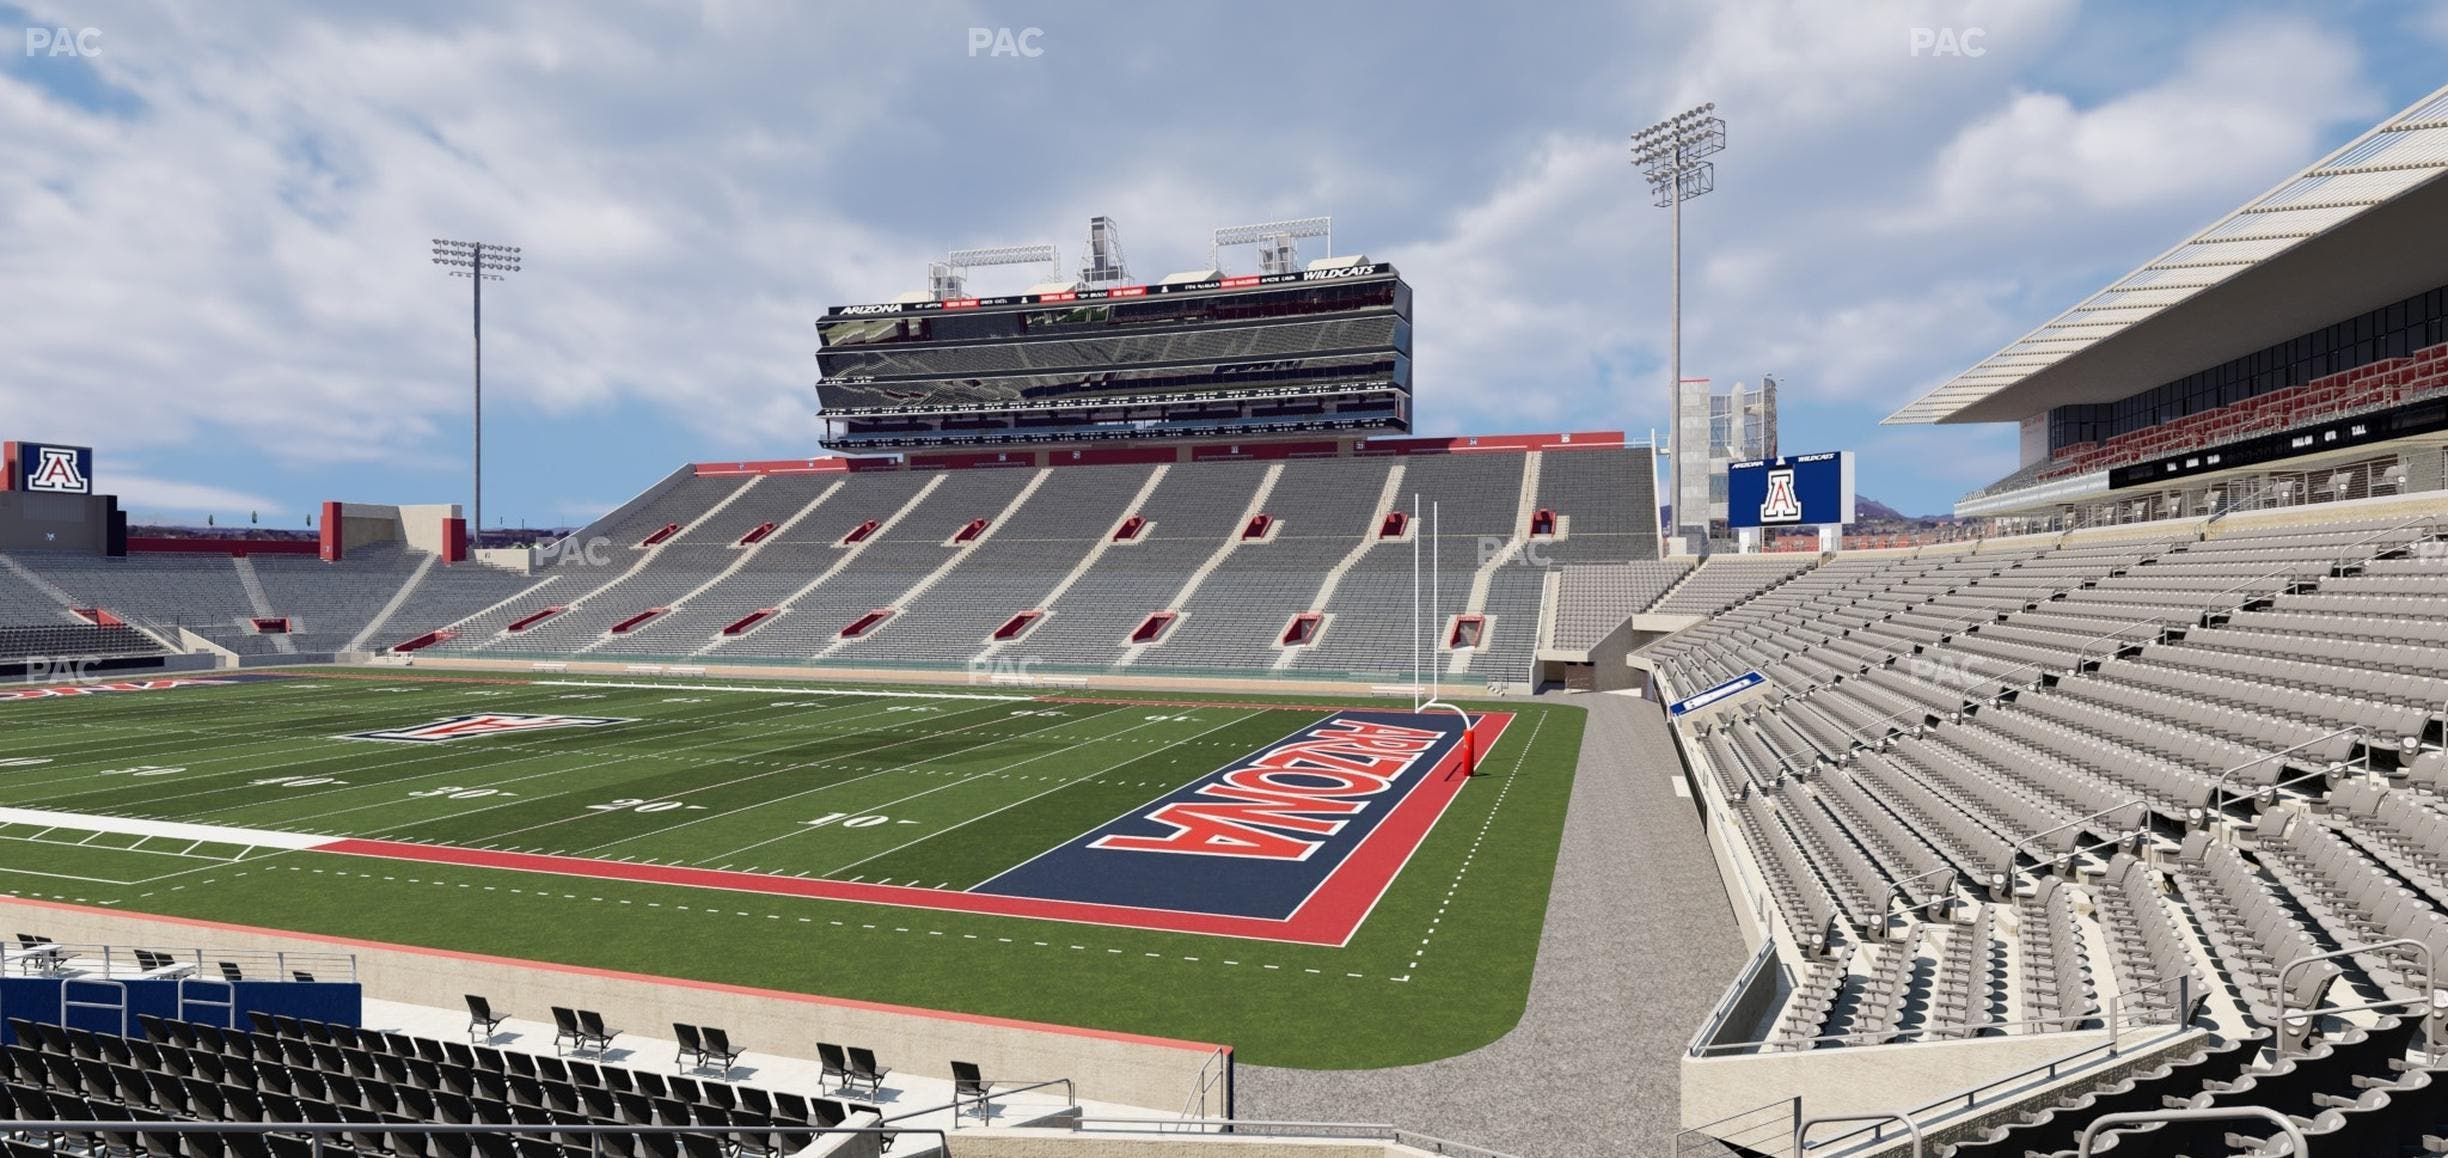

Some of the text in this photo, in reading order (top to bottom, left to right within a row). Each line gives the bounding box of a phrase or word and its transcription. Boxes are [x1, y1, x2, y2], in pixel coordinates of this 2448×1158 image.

[1303, 265, 1376, 281] WILDCATS
[840, 304, 902, 315] ARIZONA
[28, 447, 88, 493] A
[1760, 469, 1801, 522] A
[1086, 719, 1446, 861] ARIZONA
[585, 798, 684, 813] 20
[797, 811, 889, 828] 10
